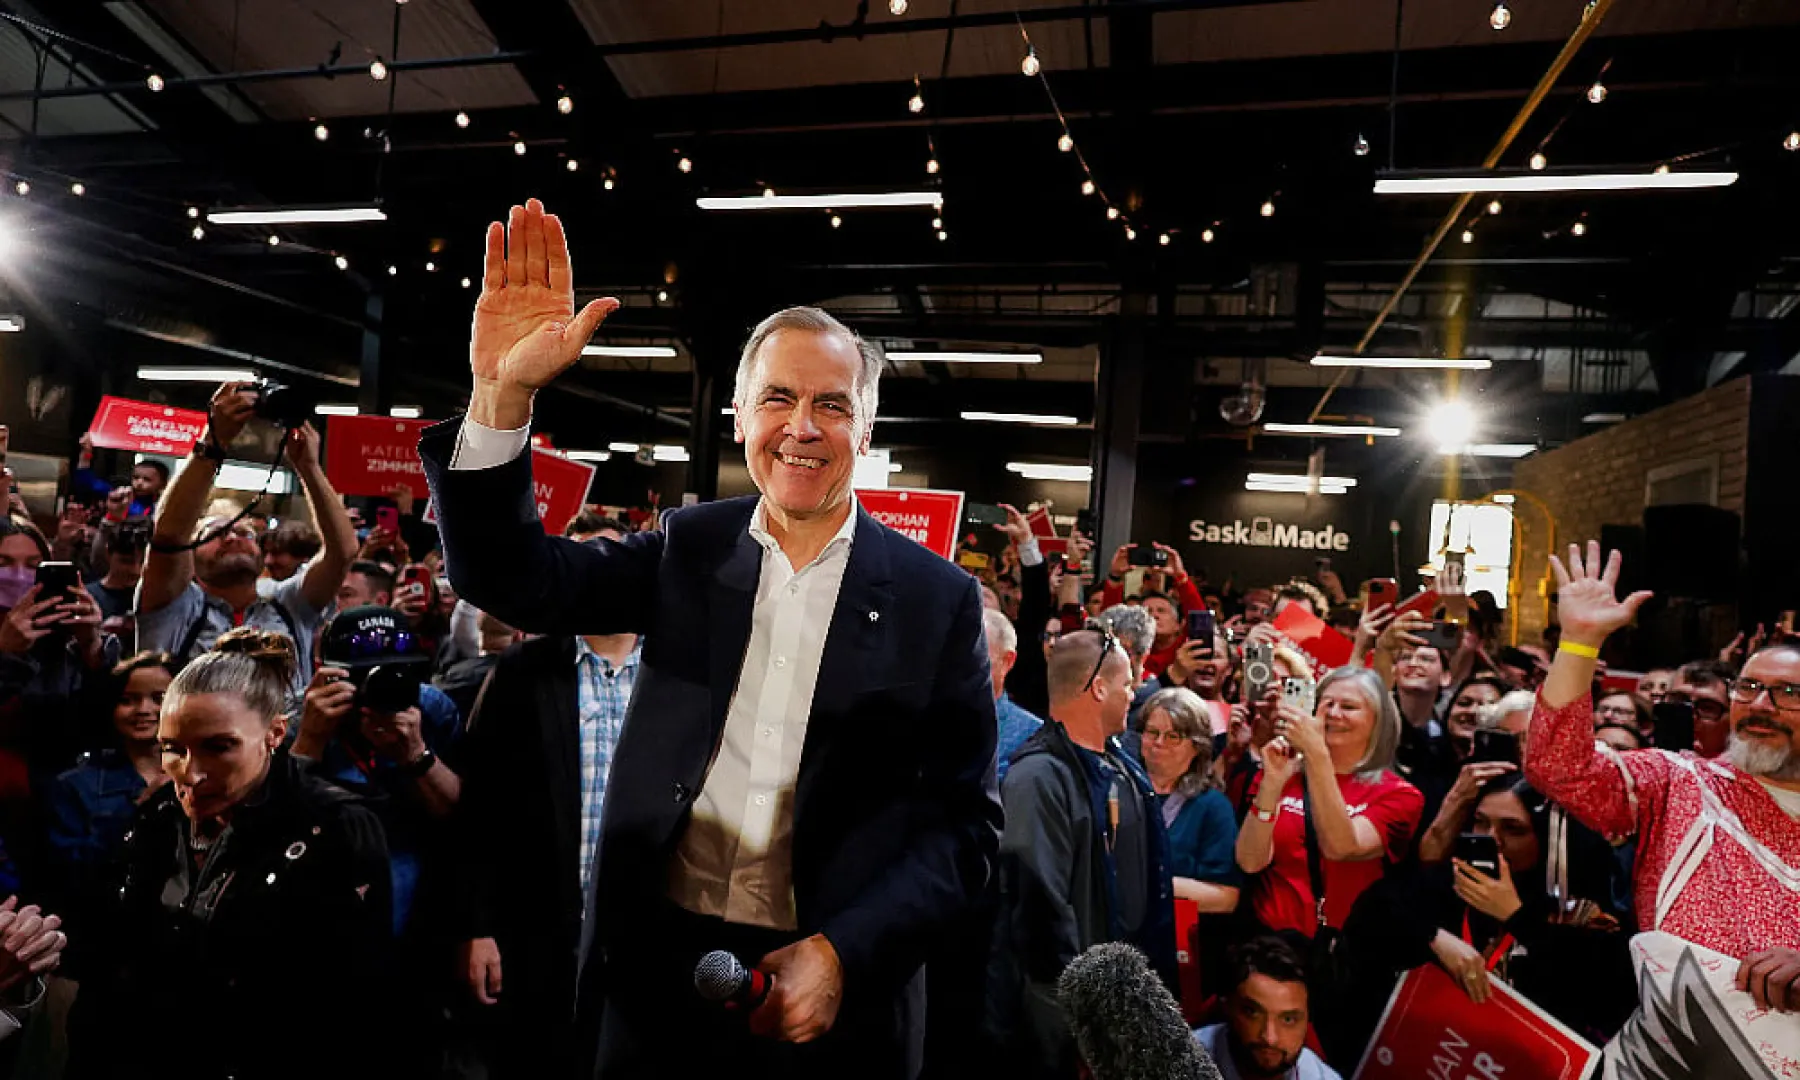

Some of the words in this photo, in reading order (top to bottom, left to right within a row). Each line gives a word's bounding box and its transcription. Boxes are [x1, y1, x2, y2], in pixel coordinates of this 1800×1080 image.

[361, 444, 418, 460] KATEL
[1189, 519, 1250, 545] Sask
[1273, 523, 1349, 551] Made
